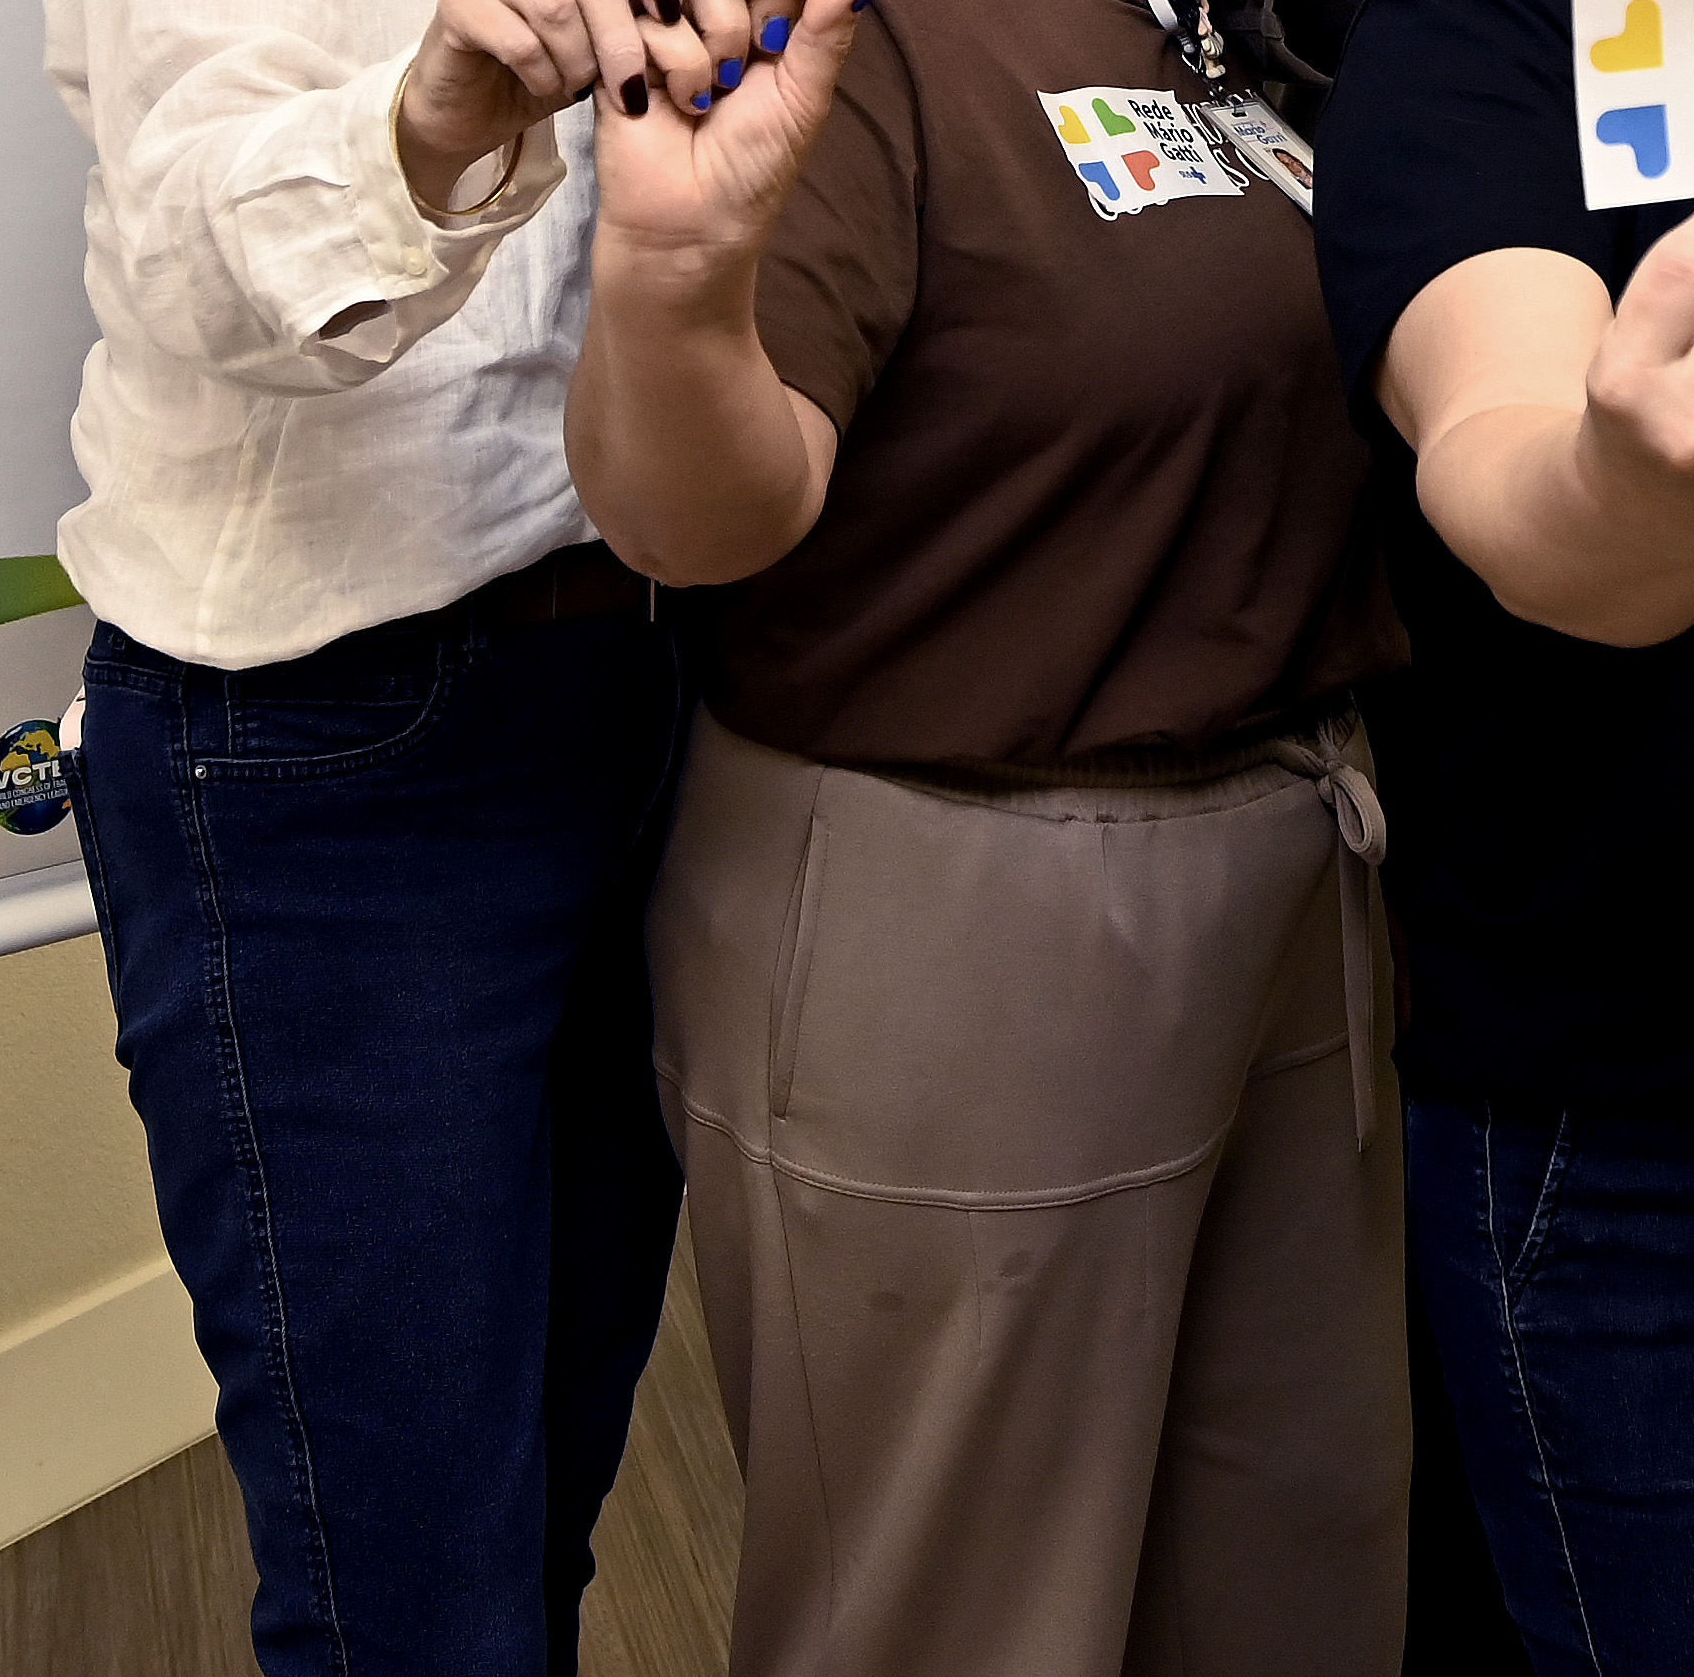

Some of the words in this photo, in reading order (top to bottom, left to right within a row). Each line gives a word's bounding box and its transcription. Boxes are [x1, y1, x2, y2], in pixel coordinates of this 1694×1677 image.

[1127, 99, 1175, 121] Rede
[1142, 121, 1194, 144] Mário
[1159, 142, 1204, 163] Gatti
